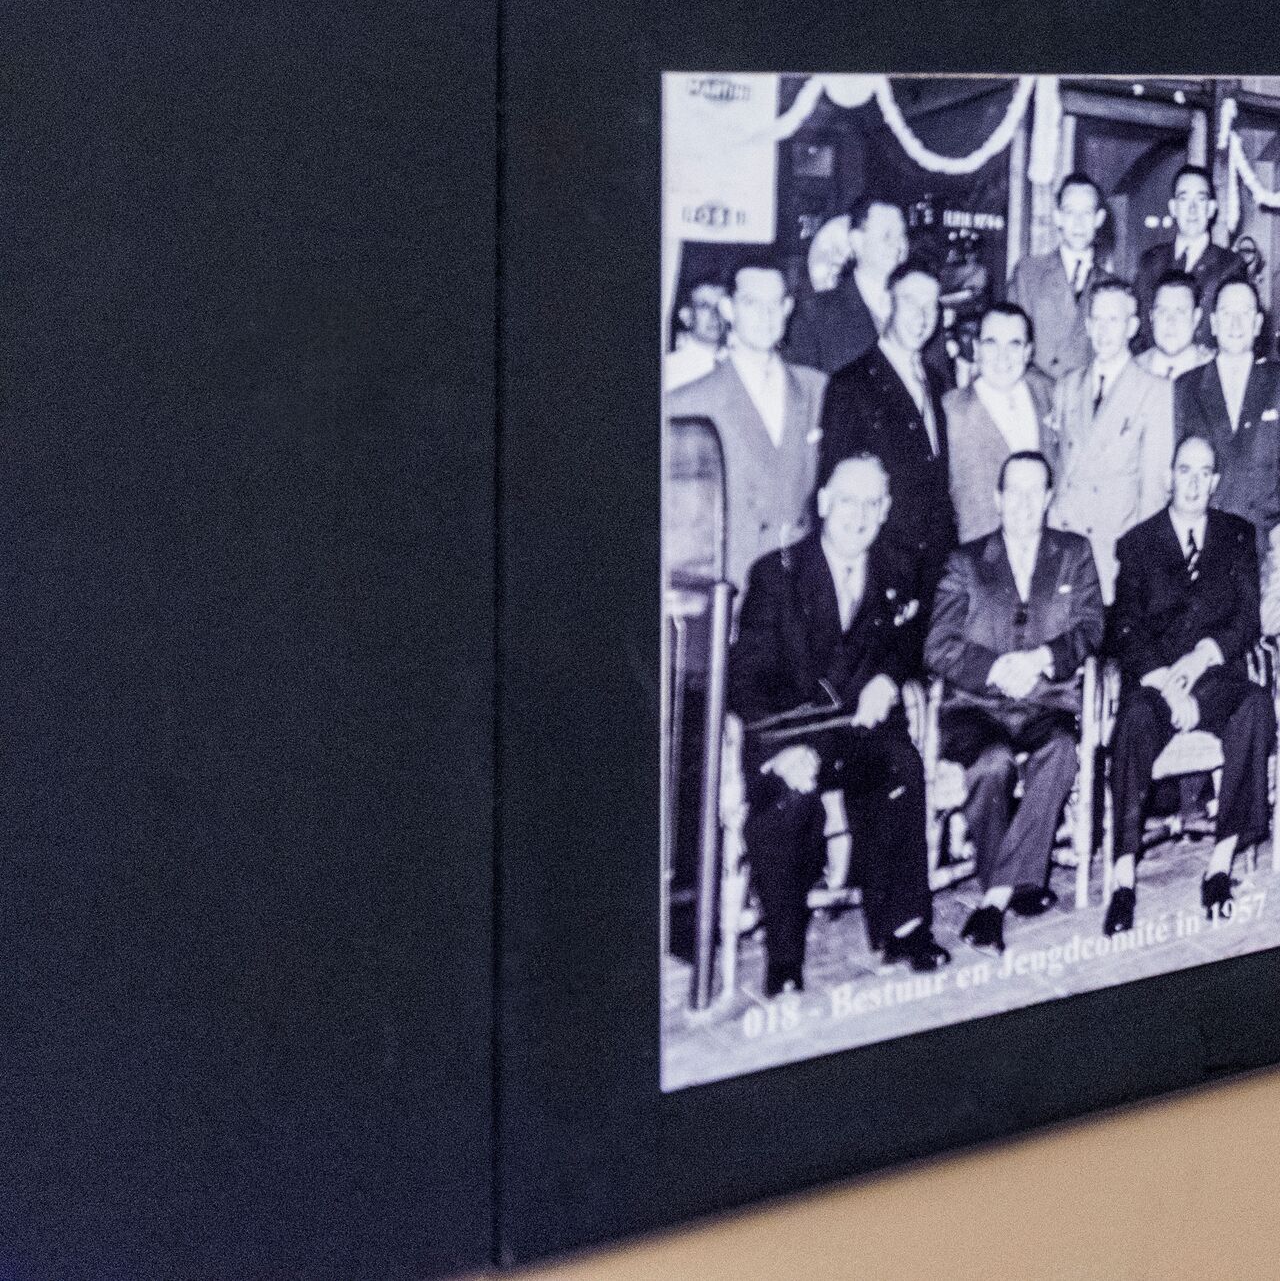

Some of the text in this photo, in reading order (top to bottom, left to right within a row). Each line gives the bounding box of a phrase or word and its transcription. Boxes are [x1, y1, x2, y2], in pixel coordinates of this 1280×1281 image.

[742, 993, 800, 1038] 018
[830, 971, 949, 1019] Bestuur
[956, 960, 991, 989] en
[1175, 910, 1201, 937] in
[1210, 892, 1267, 930] 1957
